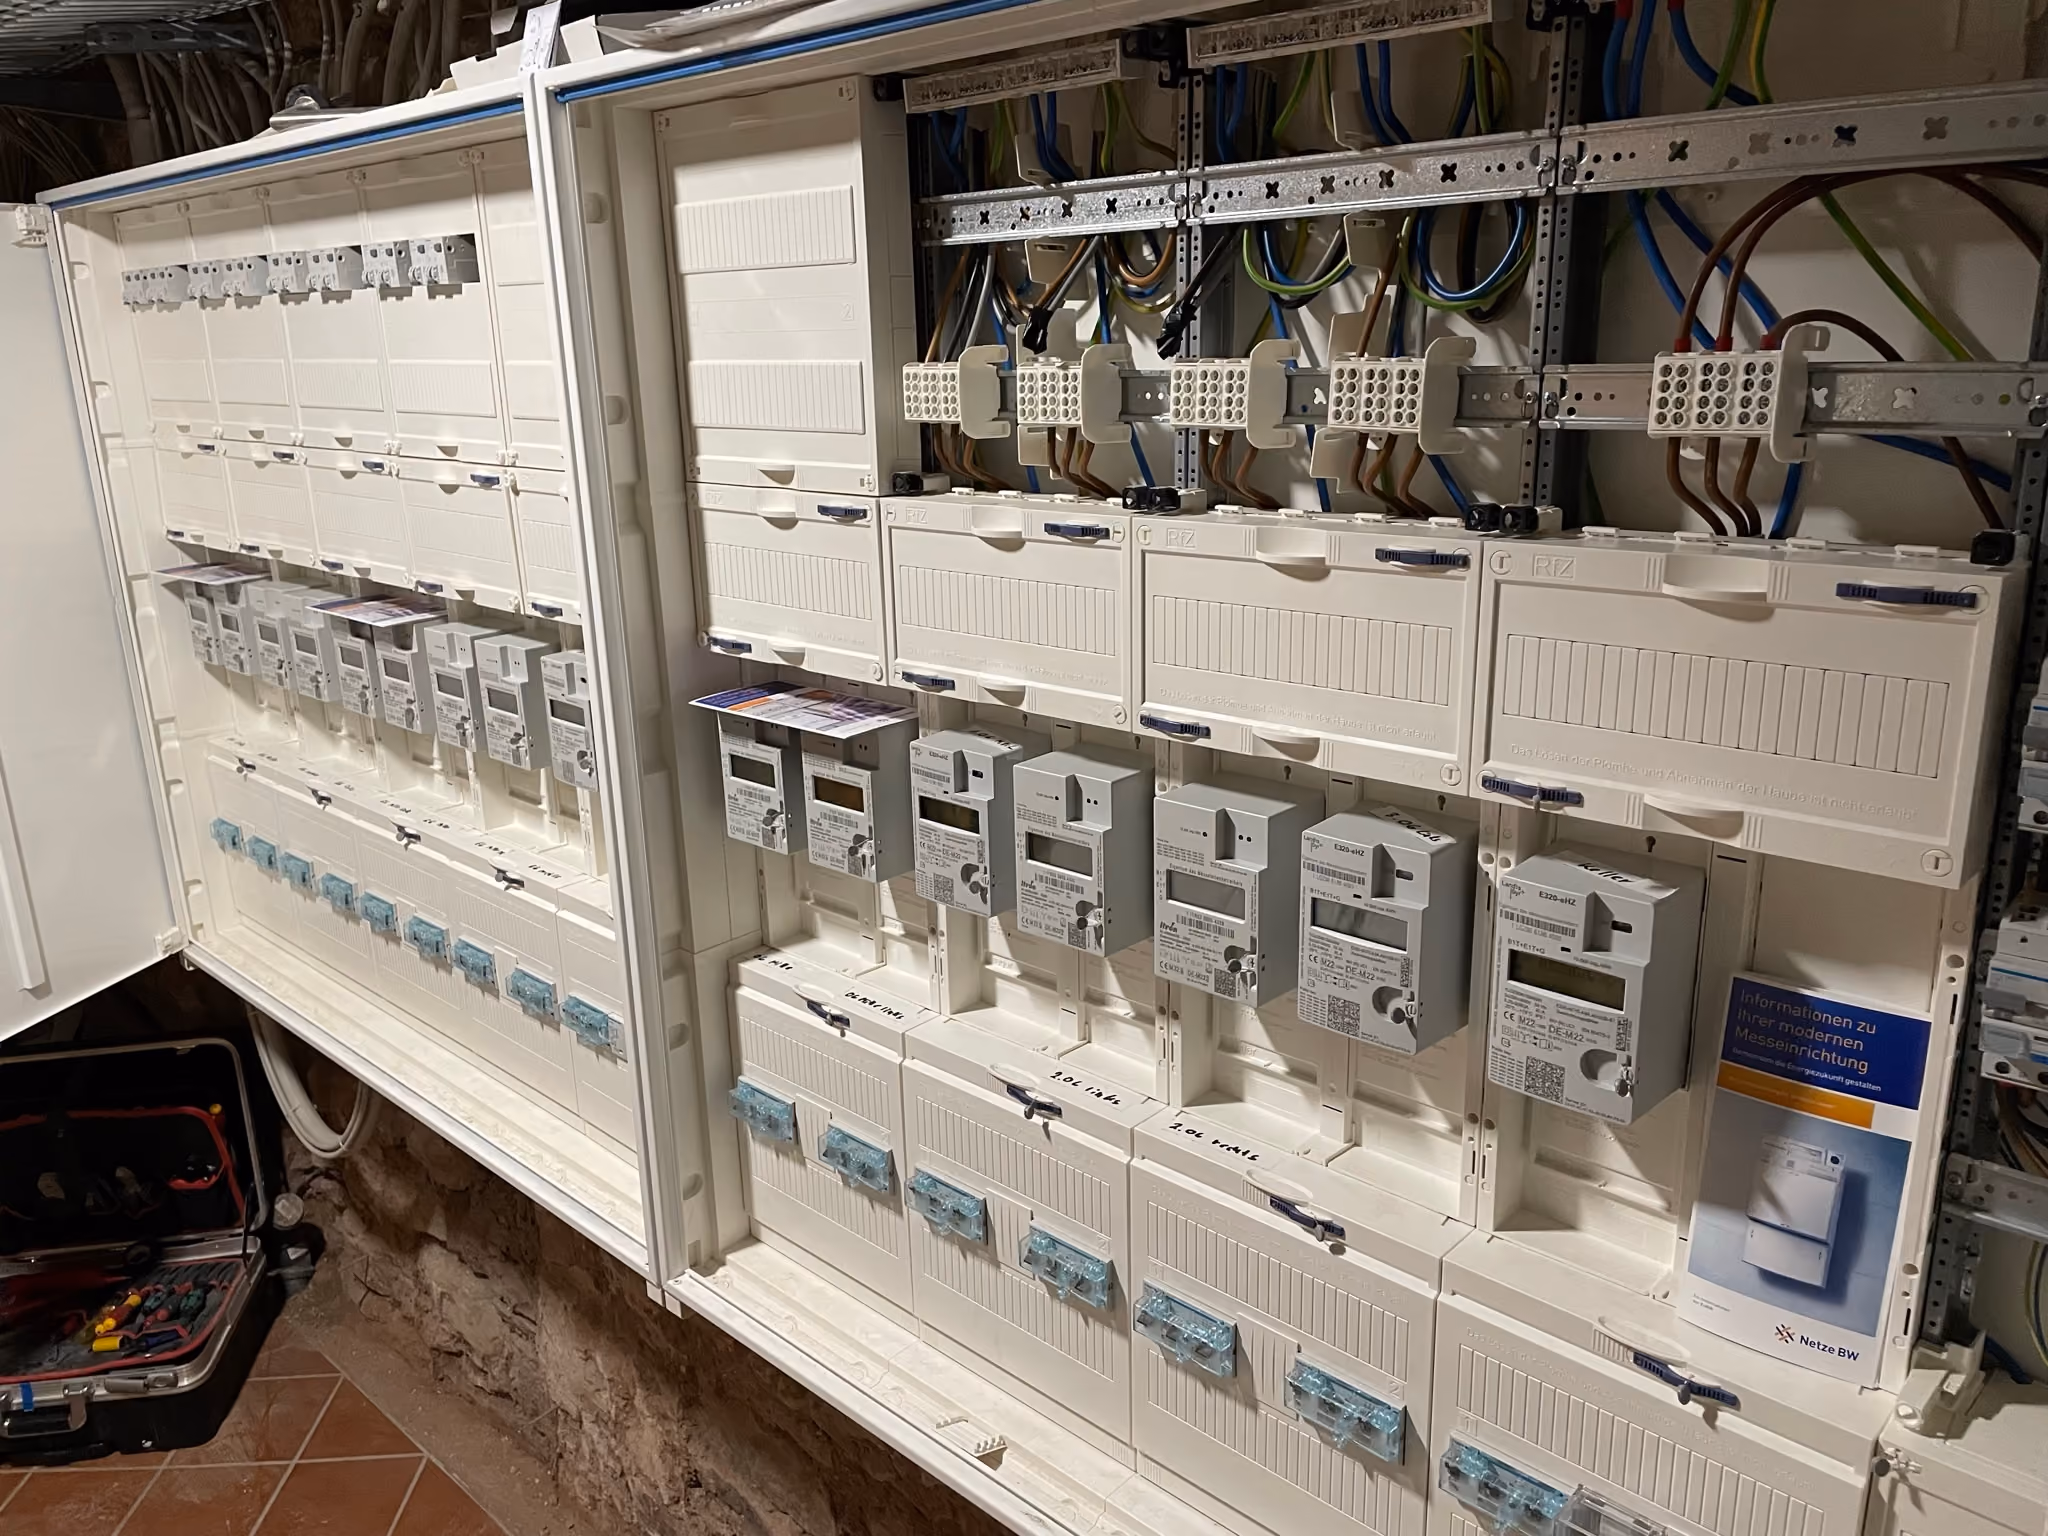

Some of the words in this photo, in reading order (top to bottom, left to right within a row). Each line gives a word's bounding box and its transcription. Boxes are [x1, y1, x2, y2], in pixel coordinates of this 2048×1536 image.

[1737, 1008, 1775, 1029] Ihrer
[1778, 1021, 1864, 1051] modernen
[1740, 989, 1852, 1029] Informationen
[1857, 1020, 1877, 1034] zu
[1735, 1026, 1869, 1075] Messeinrichtung
[1845, 1077, 1882, 1092] gestalten
[1800, 1335, 1835, 1354] Netze
[1837, 1347, 1859, 1361] BW
